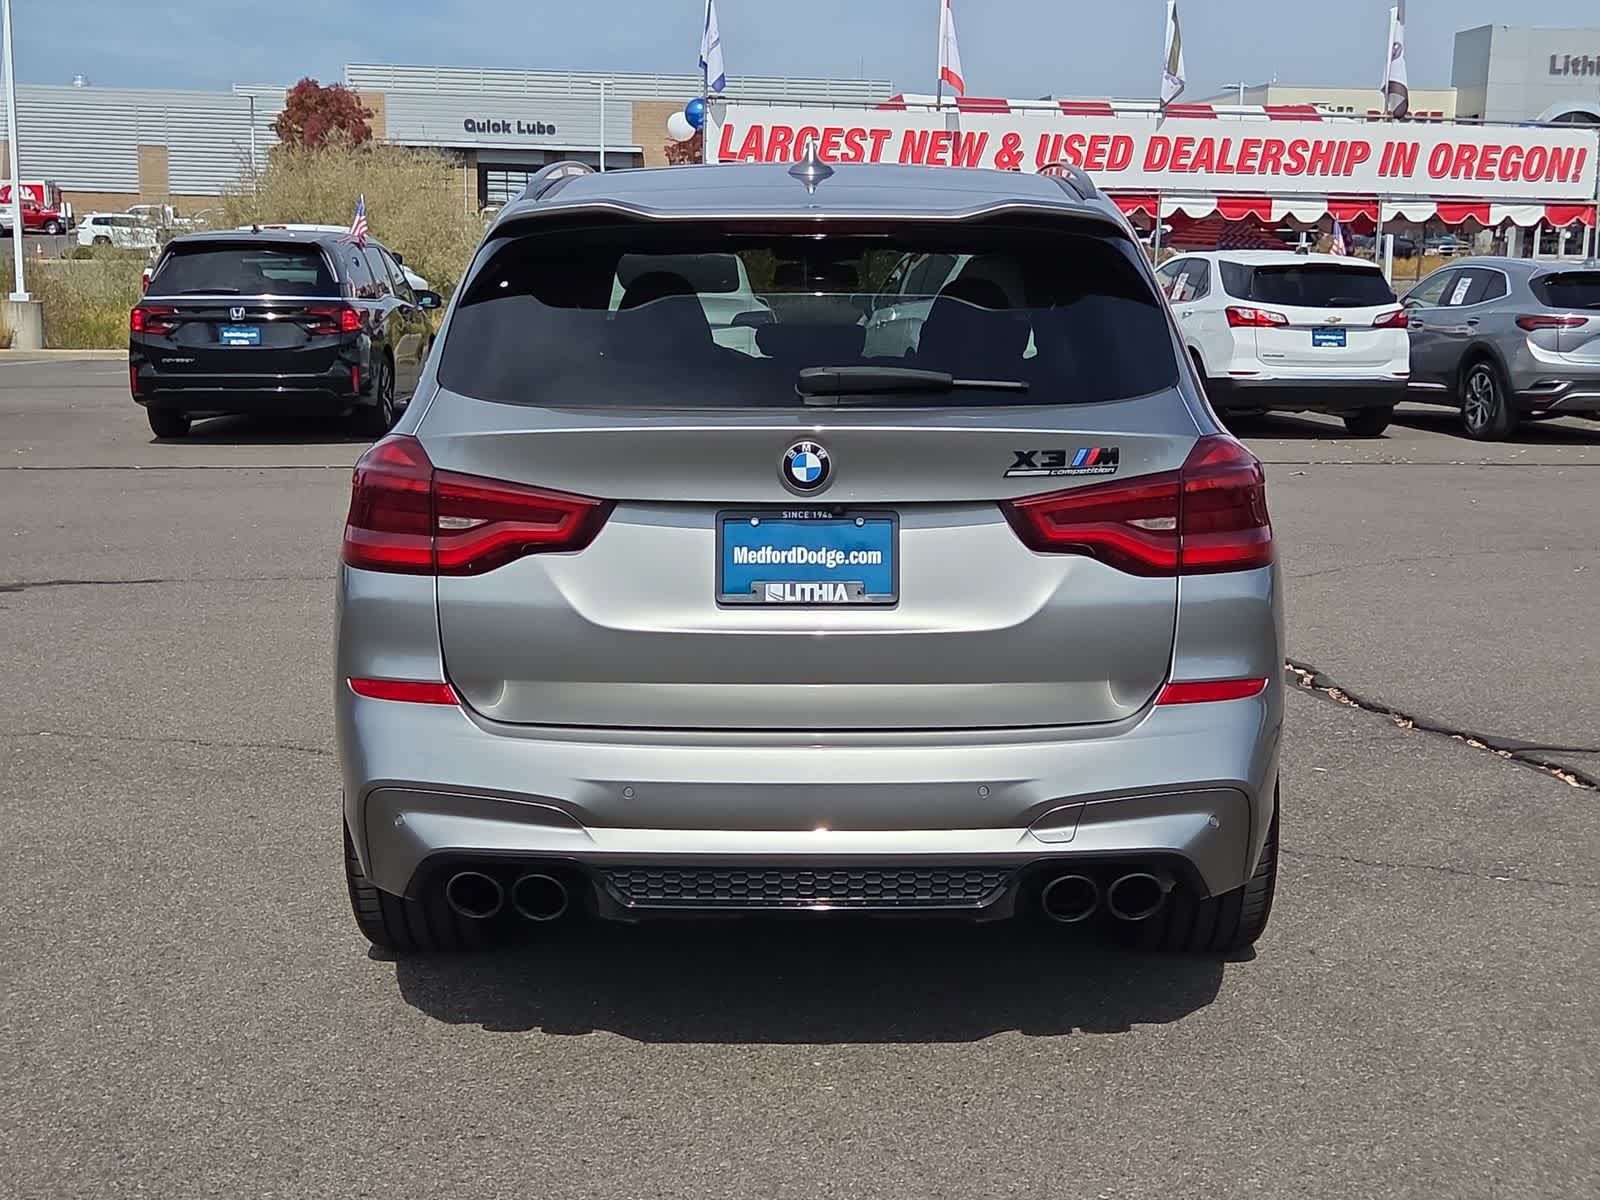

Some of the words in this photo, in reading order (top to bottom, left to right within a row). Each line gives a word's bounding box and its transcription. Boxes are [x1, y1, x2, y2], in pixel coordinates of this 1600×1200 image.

[464, 118, 512, 134] Quick
[517, 120, 556, 135] Lube
[718, 123, 892, 163] LARGEST
[898, 129, 989, 168] NEW
[993, 131, 1025, 170] &
[1035, 133, 1135, 173] USED
[1142, 135, 1371, 176] DEALERSHIP
[1377, 141, 1420, 177] IN
[1427, 142, 1588, 183] OREGON!
[787, 443, 828, 460] BMW
[1009, 449, 1067, 468] X3
[1050, 466, 1116, 477] competition
[782, 510, 809, 519] SINCE
[733, 546, 882, 569] MedfordDodge.com
[785, 583, 849, 602] LITHIA
